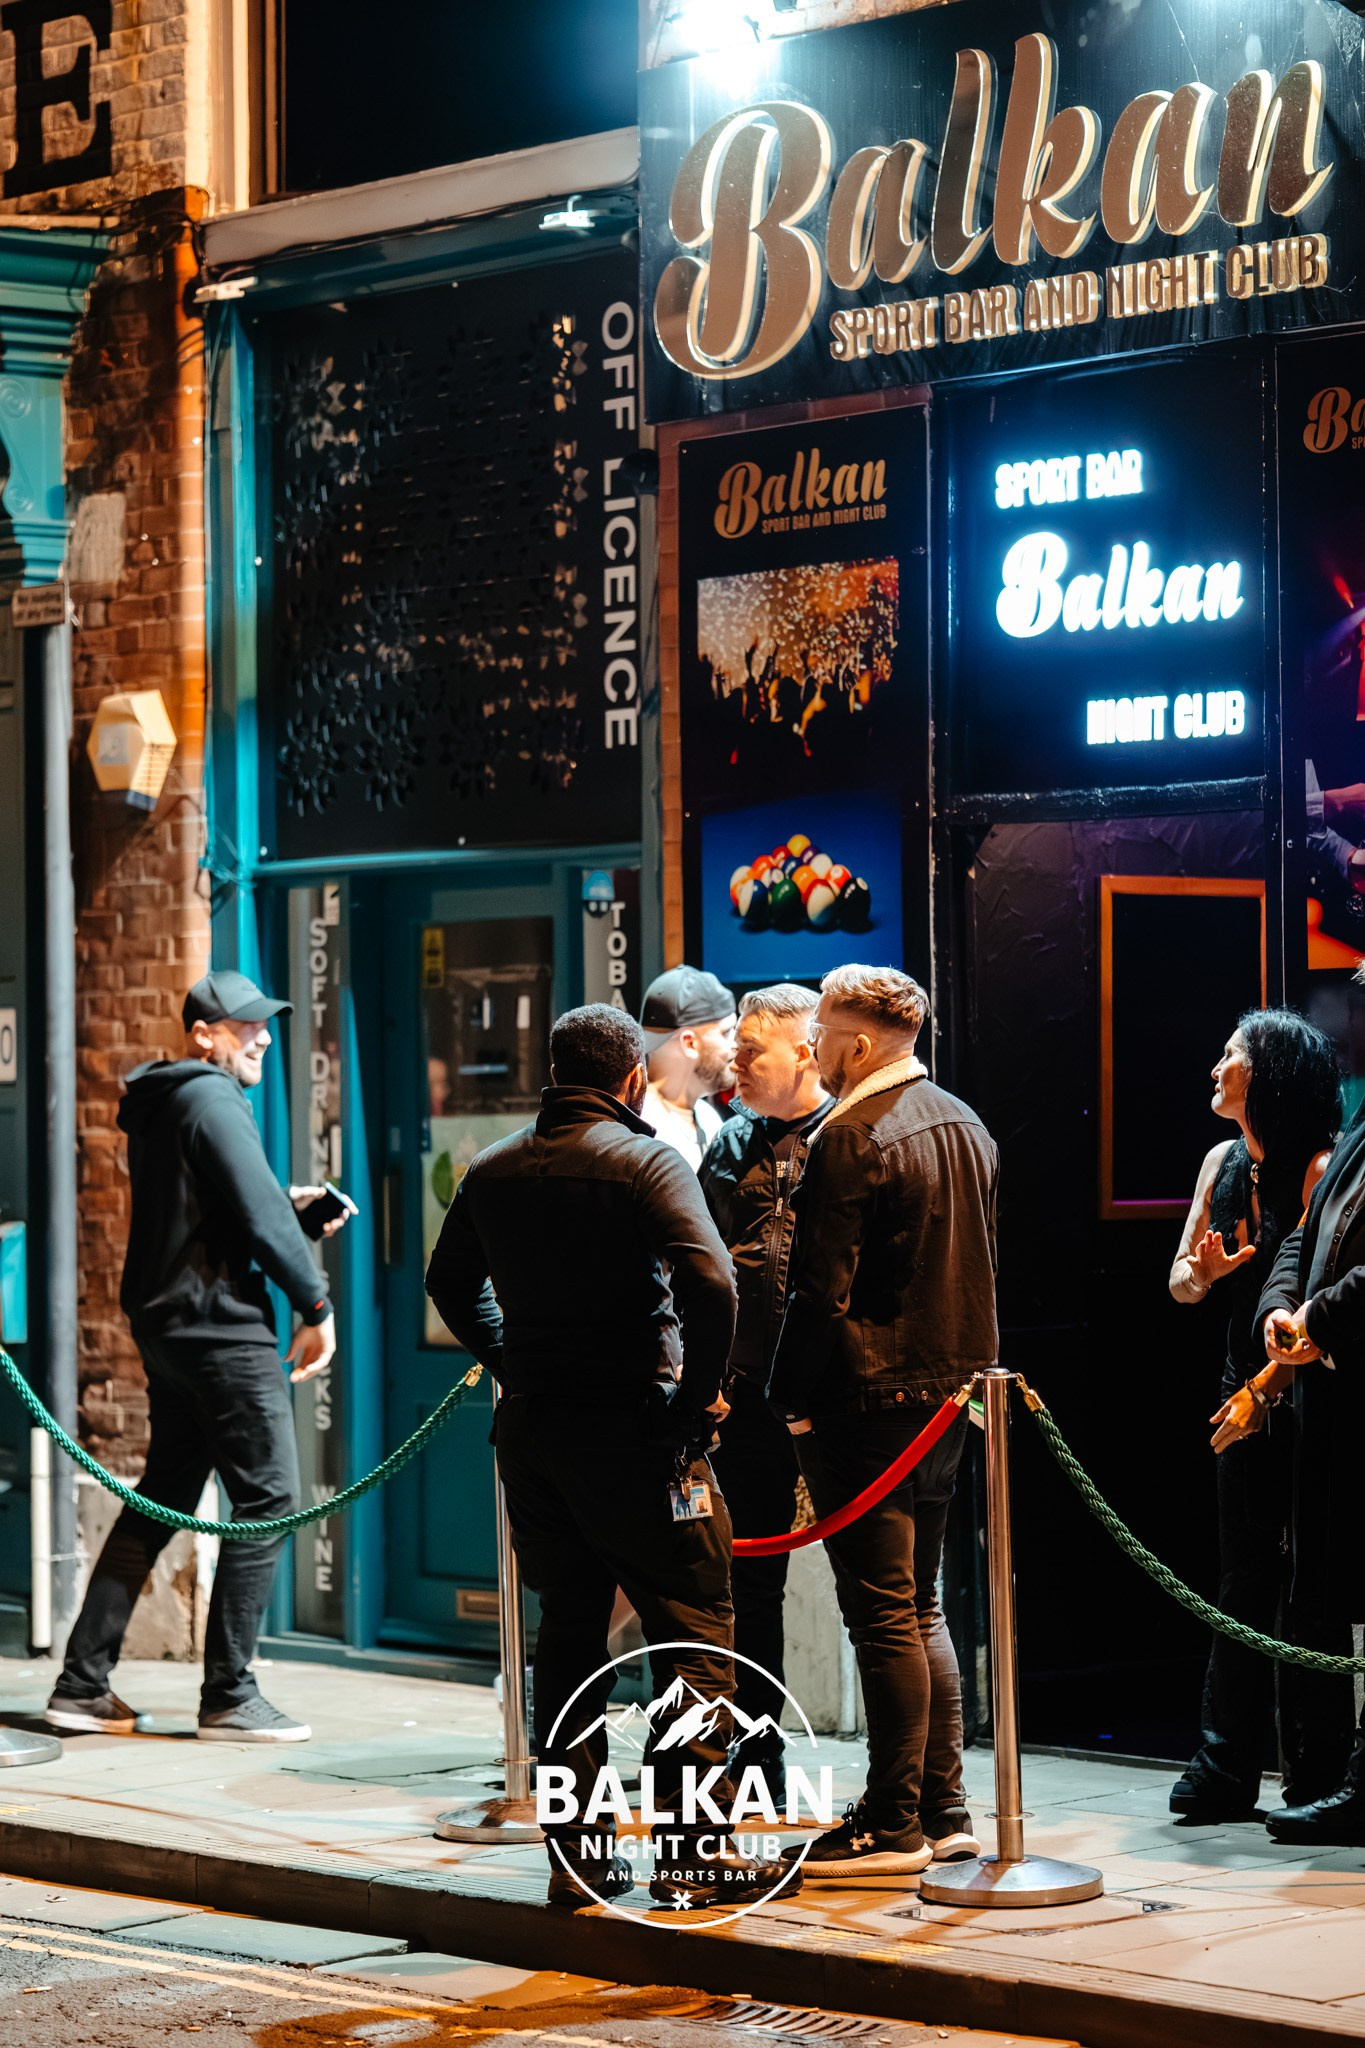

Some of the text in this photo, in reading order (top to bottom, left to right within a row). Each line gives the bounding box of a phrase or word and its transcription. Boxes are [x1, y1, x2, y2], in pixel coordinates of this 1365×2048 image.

[653, 32, 1333, 380] Balkan
[829, 232, 1329, 361] SPORT BAR AND NIGHT CLUB
[601, 301, 638, 751] OFF LICENCE
[713, 447, 887, 539] Balkan
[762, 503, 887, 535] SPORT BAR AND NIGHT CLUB
[994, 448, 1144, 510] SPORT BAR
[995, 531, 1244, 639] Balkan
[1173, 689, 1246, 740] CLUB
[310, 917, 328, 1029] SOFT
